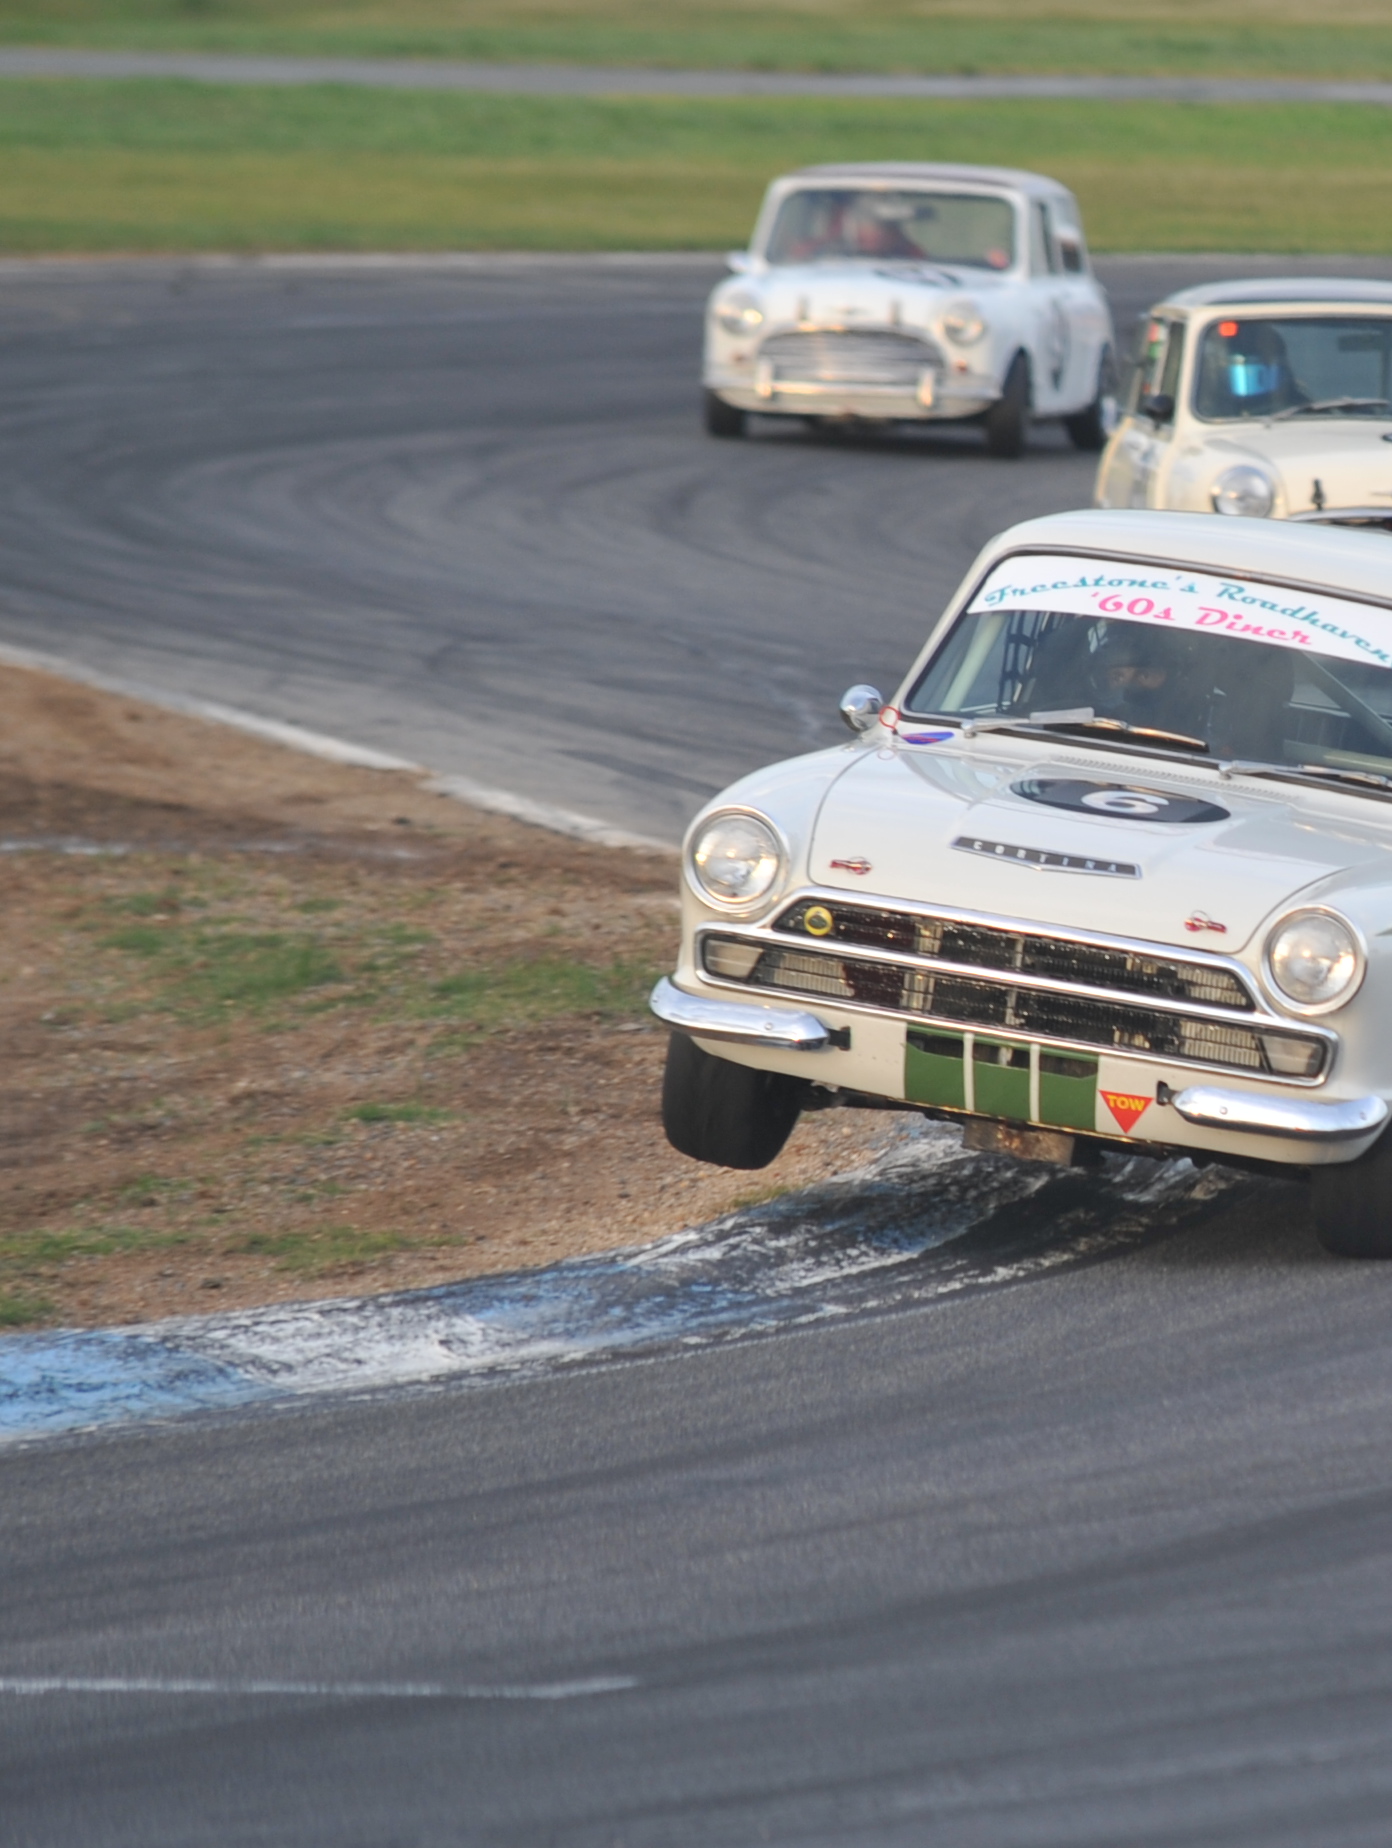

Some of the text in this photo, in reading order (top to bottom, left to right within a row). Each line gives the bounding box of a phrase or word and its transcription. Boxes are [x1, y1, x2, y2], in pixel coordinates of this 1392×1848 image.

[984, 574, 1390, 662] Freestone's Roadhaven
[1195, 606, 1312, 645] Diner
[1081, 790, 1170, 814] 6
[972, 840, 1117, 873] CORTINA
[1106, 1094, 1146, 1112] TOW
